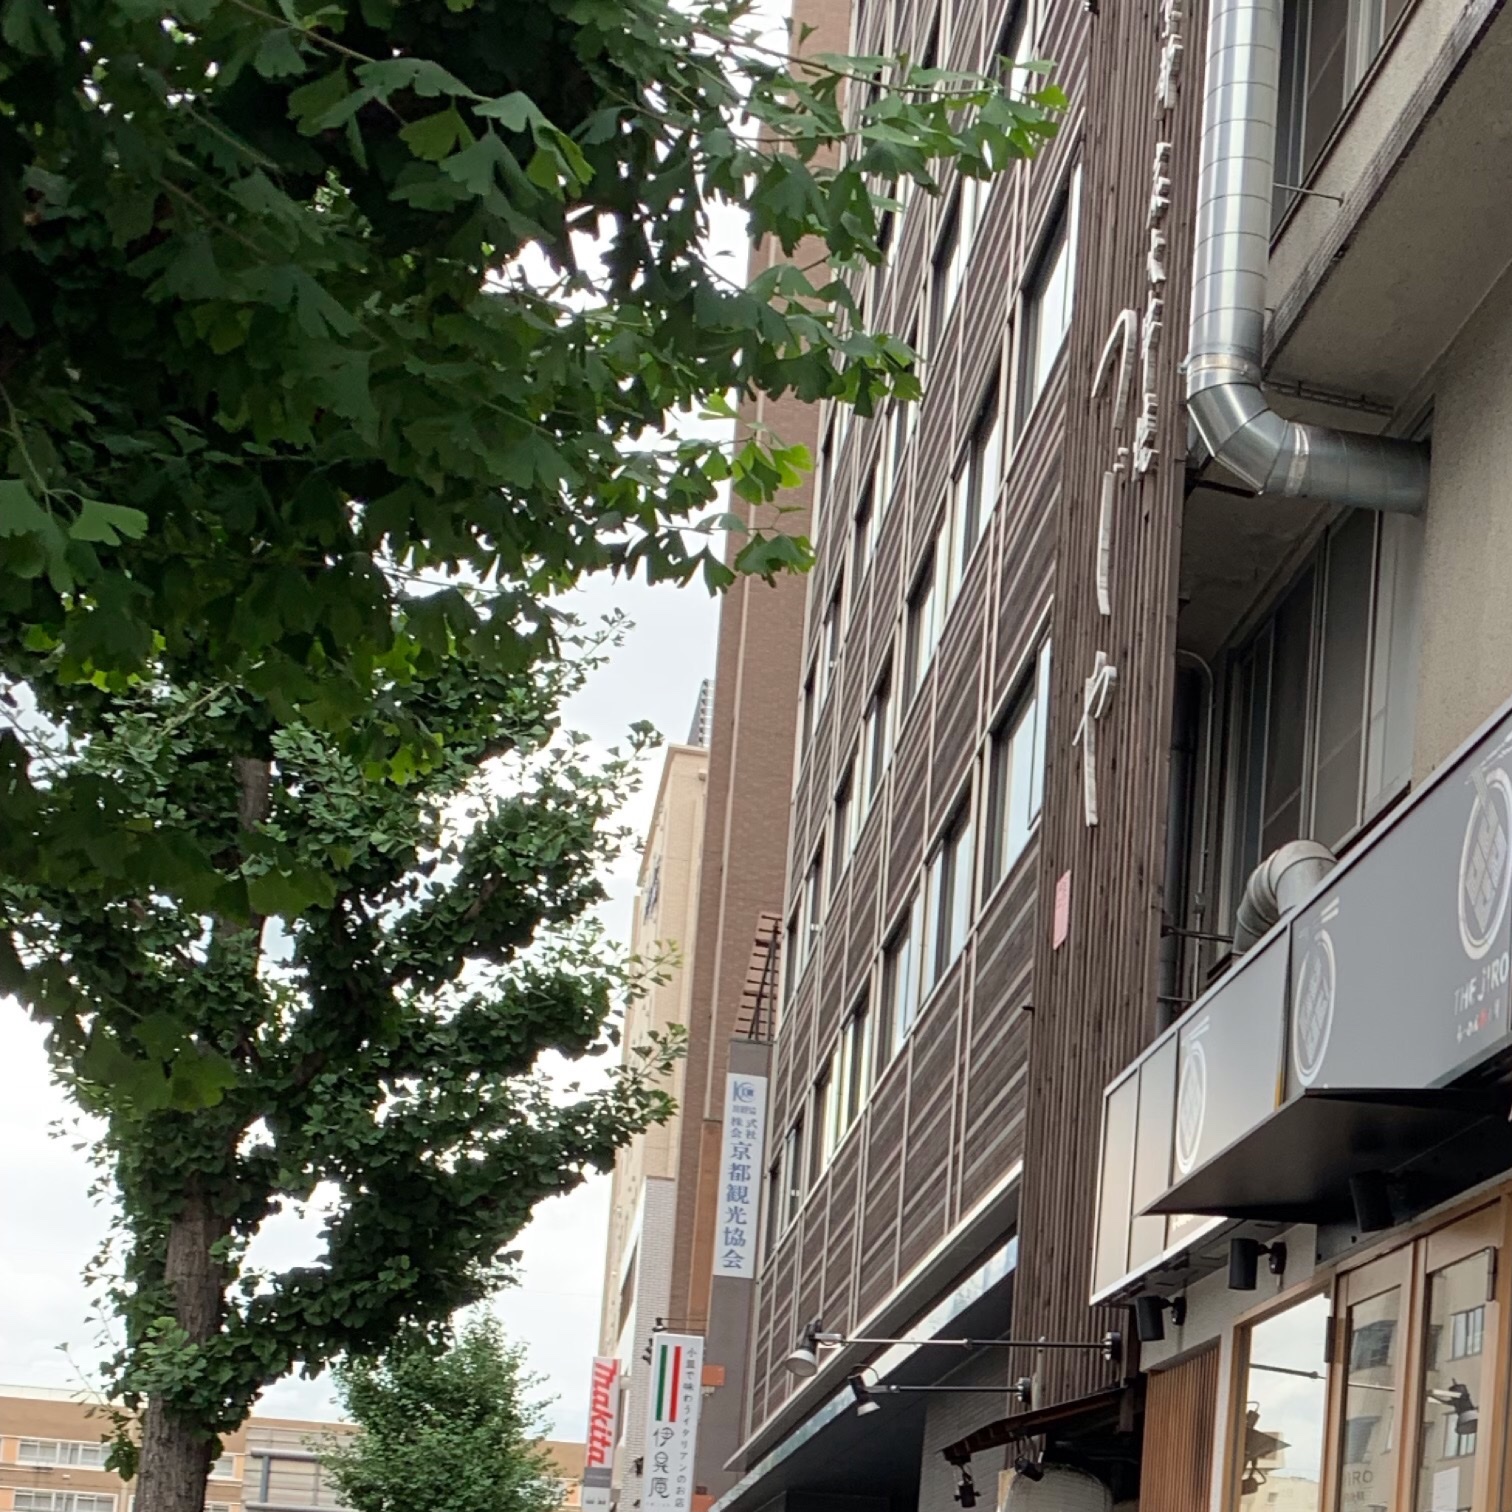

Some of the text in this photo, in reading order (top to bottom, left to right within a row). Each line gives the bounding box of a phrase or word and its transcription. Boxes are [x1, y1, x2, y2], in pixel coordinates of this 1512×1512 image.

[722, 1141, 753, 1270] 京都観光協会
